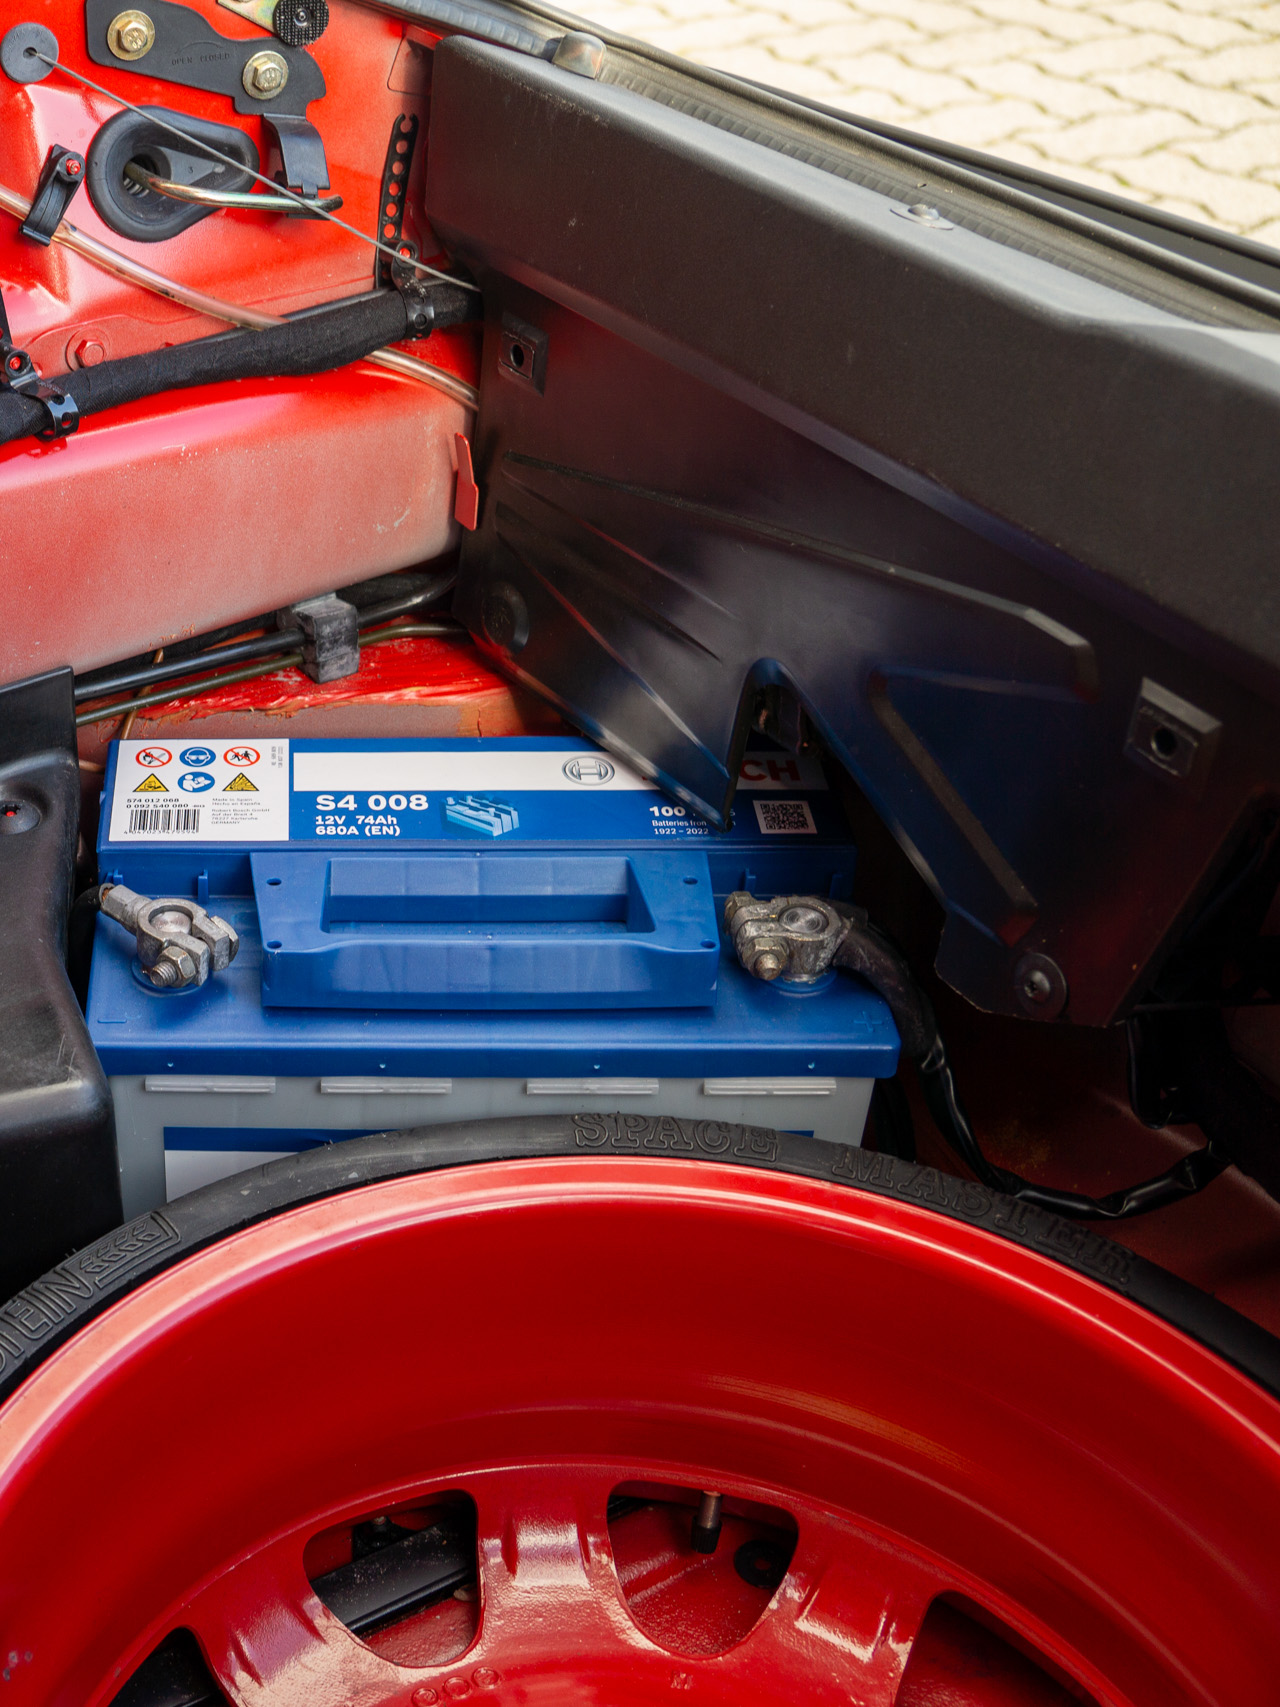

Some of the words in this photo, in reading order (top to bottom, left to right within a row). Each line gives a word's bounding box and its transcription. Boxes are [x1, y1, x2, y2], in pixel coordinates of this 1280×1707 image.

[172, 56, 192, 66] OPEN
[200, 52, 230, 62] CLOSED
[316, 794, 357, 811] S4
[367, 794, 429, 811] 008
[649, 806, 686, 817] 100
[315, 815, 345, 826] 12V
[356, 815, 397, 826] 74Ah
[315, 825, 359, 835] 680A
[365, 825, 401, 837] (EN)
[572, 1112, 780, 1164] SPACE
[832, 1141, 1138, 1286] MASTER
